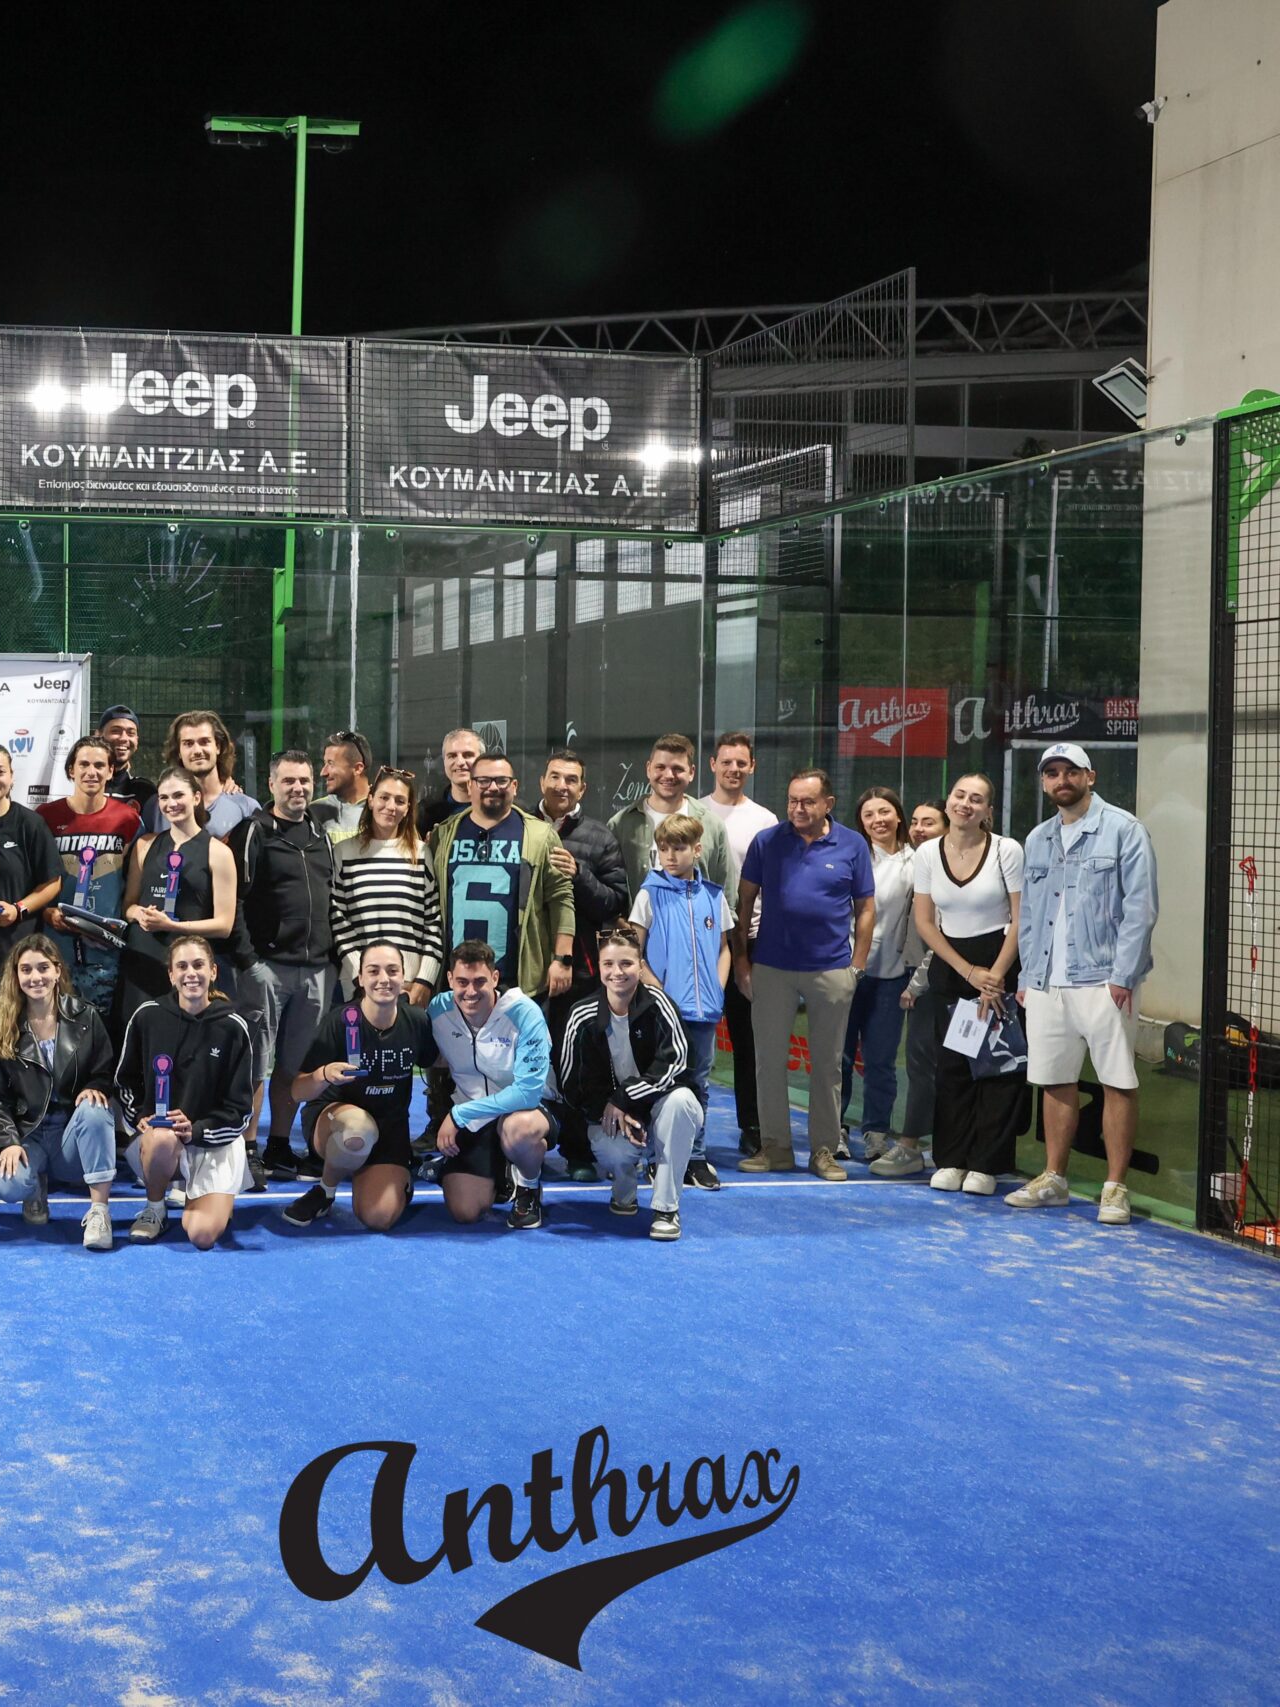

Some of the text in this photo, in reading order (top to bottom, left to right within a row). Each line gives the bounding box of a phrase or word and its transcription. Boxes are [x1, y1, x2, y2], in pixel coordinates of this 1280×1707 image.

[81, 352, 257, 429] Jeep
[444, 375, 612, 451] Jeep
[21, 443, 317, 474] ΚΟΥΜΑΝΤΖΙΑΣ Α.Ε.
[389, 465, 667, 497] ΚΟΥΜΑΝΤΖΙΑΣ Α.Ε.
[33, 677, 70, 691] Jeep
[838, 695, 932, 733] Anthrax
[1106, 699, 1139, 718] CUST
[1107, 719, 1138, 736] SPOR
[452, 864, 511, 963] 6
